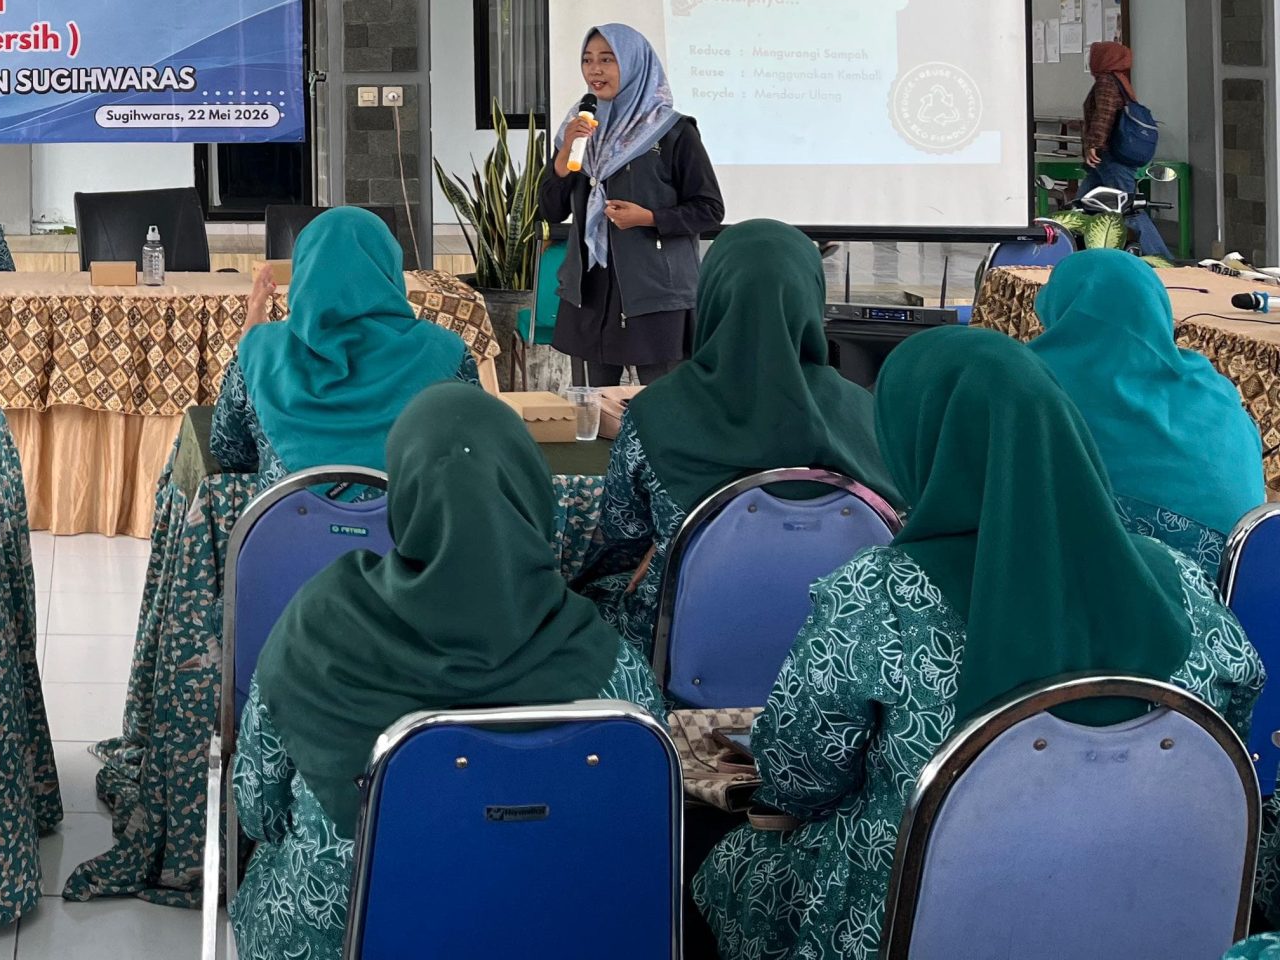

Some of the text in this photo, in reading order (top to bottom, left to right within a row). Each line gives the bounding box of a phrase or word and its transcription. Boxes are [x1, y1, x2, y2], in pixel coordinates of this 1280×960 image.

[689, 44, 731, 57] Reduce
[752, 46, 821, 61] Mengurangi
[824, 48, 869, 62] Sampah
[16, 66, 195, 94] SUGIHWARAS
[690, 66, 725, 77] Reuse
[753, 68, 834, 81] Menggunakan
[692, 87, 735, 101] Recycle
[809, 89, 842, 102] Ulang
[106, 109, 269, 123] Sugihwaras, 22 Mei 2026
